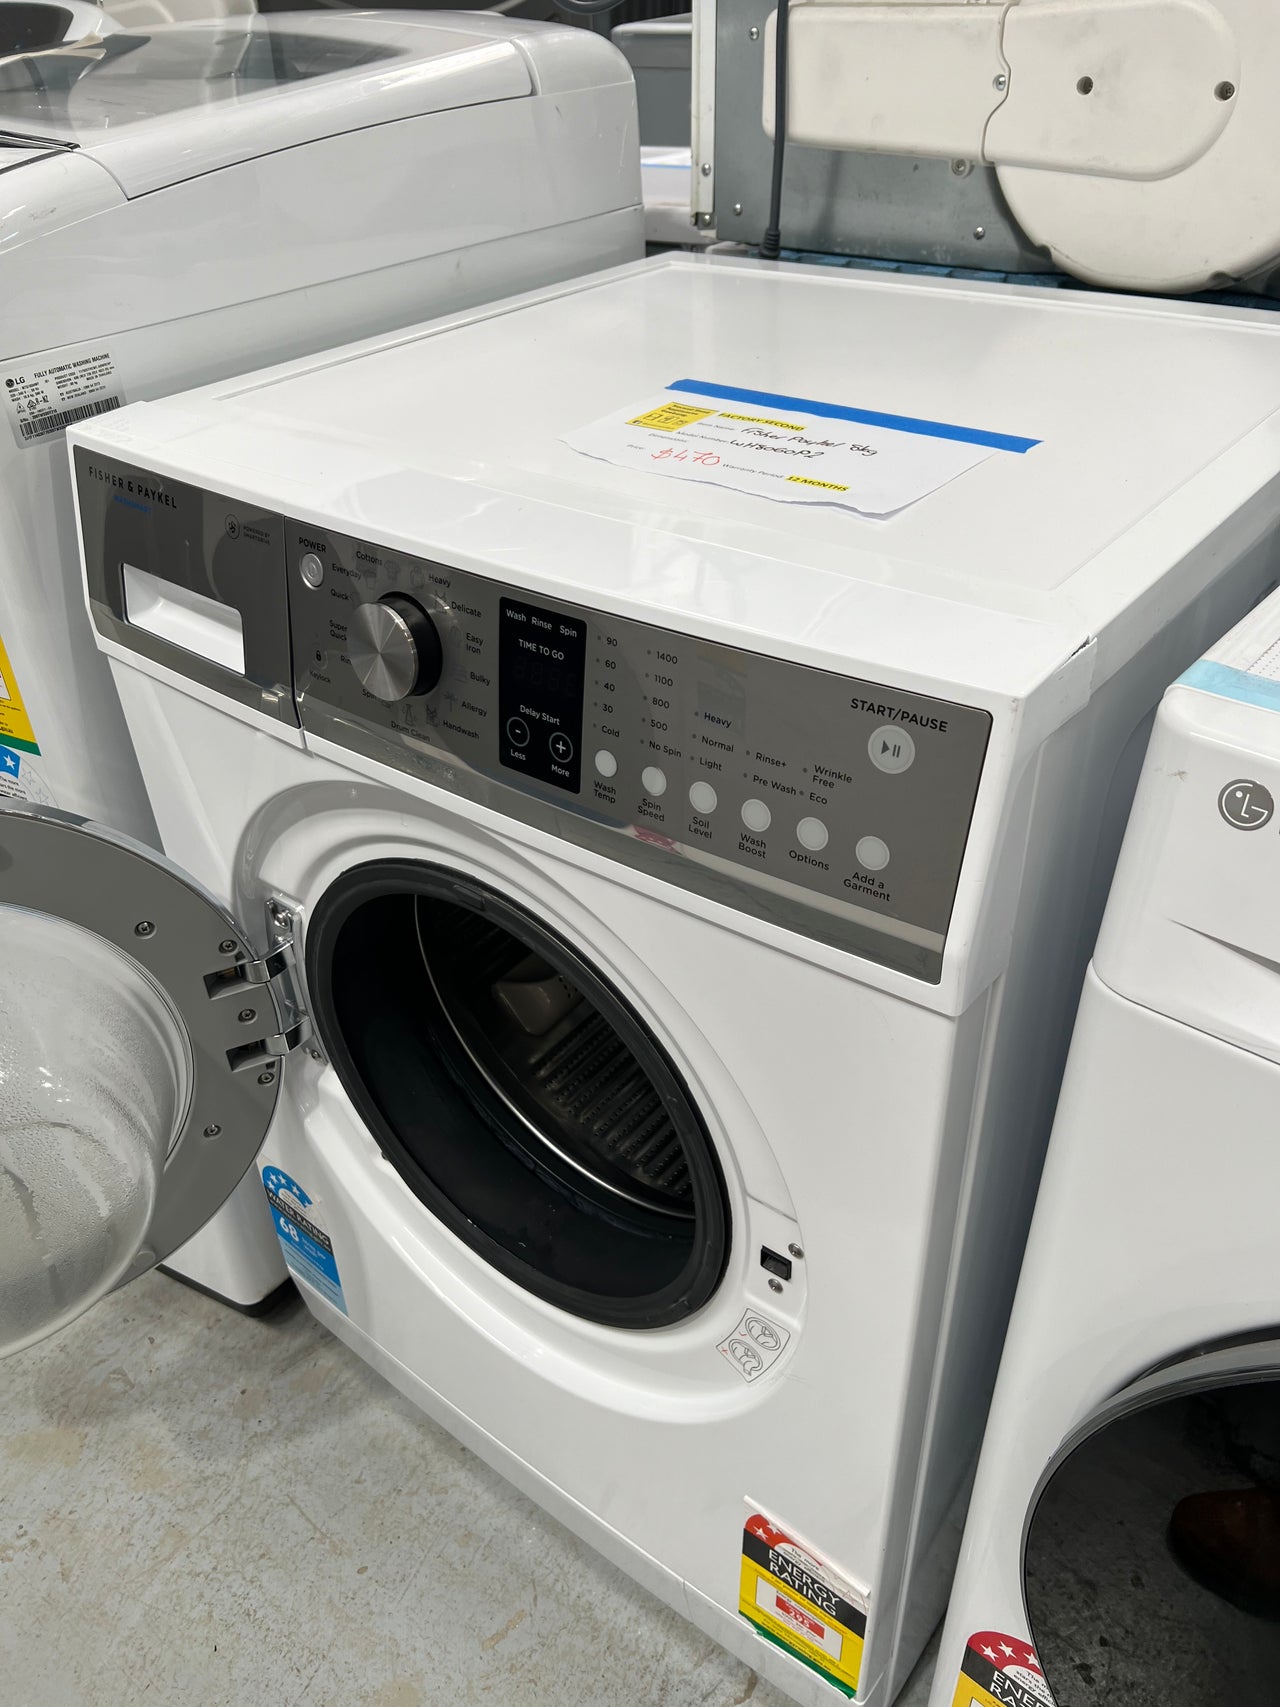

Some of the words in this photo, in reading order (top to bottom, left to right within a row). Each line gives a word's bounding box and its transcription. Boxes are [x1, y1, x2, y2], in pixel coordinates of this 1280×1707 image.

[34, 370, 48, 378] FULLY
[49, 364, 72, 374] AUTOMATIC
[72, 358, 92, 368] WASHING
[92, 353, 110, 362] MACHINE
[15, 376, 26, 384] LG
[718, 412, 761, 424] FACTORY
[761, 420, 804, 431] SECOND
[651, 448, 721, 466] $470
[88, 465, 124, 489] FISHER
[127, 480, 135, 494] &
[137, 484, 178, 509] PAYKEL
[800, 478, 849, 492] MONTHS
[299, 537, 326, 552] POWER
[356, 551, 383, 566] Cottons
[332, 563, 361, 580] Everyday
[429, 573, 451, 588] Heavy
[331, 588, 349, 601] Quick
[451, 601, 482, 618] Delicate
[329, 620, 347, 633] Super
[506, 609, 526, 622] Wash
[531, 616, 552, 630] Rinse
[560, 625, 577, 637] Spin
[330, 630, 347, 642] Quick
[466, 633, 483, 646] Easy
[606, 637, 618, 647] 90
[466, 643, 481, 654] Iron
[518, 639, 537, 652] TIME
[539, 644, 551, 656] TO
[552, 649, 564, 661] GO
[605, 660, 616, 670] 60
[656, 651, 678, 665] 1400
[470, 672, 491, 686] Bulky
[604, 682, 615, 692] 40
[654, 674, 673, 687] 1100
[461, 701, 487, 717] Allergy
[602, 704, 614, 714] 30
[652, 697, 670, 709] 800
[520, 704, 540, 719] Delay
[542, 712, 560, 725] Start
[704, 712, 732, 729] Heavy
[850, 698, 949, 733] START/PAUSE
[391, 720, 409, 735] Drum
[411, 728, 430, 741] Clean
[443, 720, 479, 740] Handwash
[601, 725, 620, 738] Cold
[650, 719, 668, 731] 500
[649, 740, 660, 751] No
[663, 745, 681, 758] Spin
[701, 735, 734, 753] Normal
[510, 749, 526, 760] Less
[755, 752, 787, 769] Rinse+
[551, 764, 570, 778] More
[699, 757, 722, 772] Light
[812, 774, 835, 789] Free
[814, 764, 853, 784] Wrinkle
[594, 780, 616, 795] Wash
[753, 774, 769, 787] Pre
[771, 779, 797, 796] Wash
[593, 789, 616, 804] Temp
[642, 798, 661, 811] Spin
[809, 792, 828, 805] Eco
[637, 805, 665, 822] Speed
[692, 816, 710, 830] Soil
[688, 824, 713, 840] Level
[740, 832, 767, 849] Wash
[738, 841, 767, 860] Boost
[789, 850, 830, 871] Options
[852, 871, 874, 886] Add
[878, 881, 885, 889] a
[843, 878, 891, 902] Garment
[267, 1188, 296, 1218] WATER
[295, 1211, 330, 1246] RATING
[279, 1216, 299, 1242] 68
[768, 1549, 842, 1605] ENERGY
[769, 1562, 837, 1616] RATING
[790, 1609, 810, 1628] 295
[1014, 1674, 1036, 1692] energy
[1027, 1671, 1040, 1684] The
